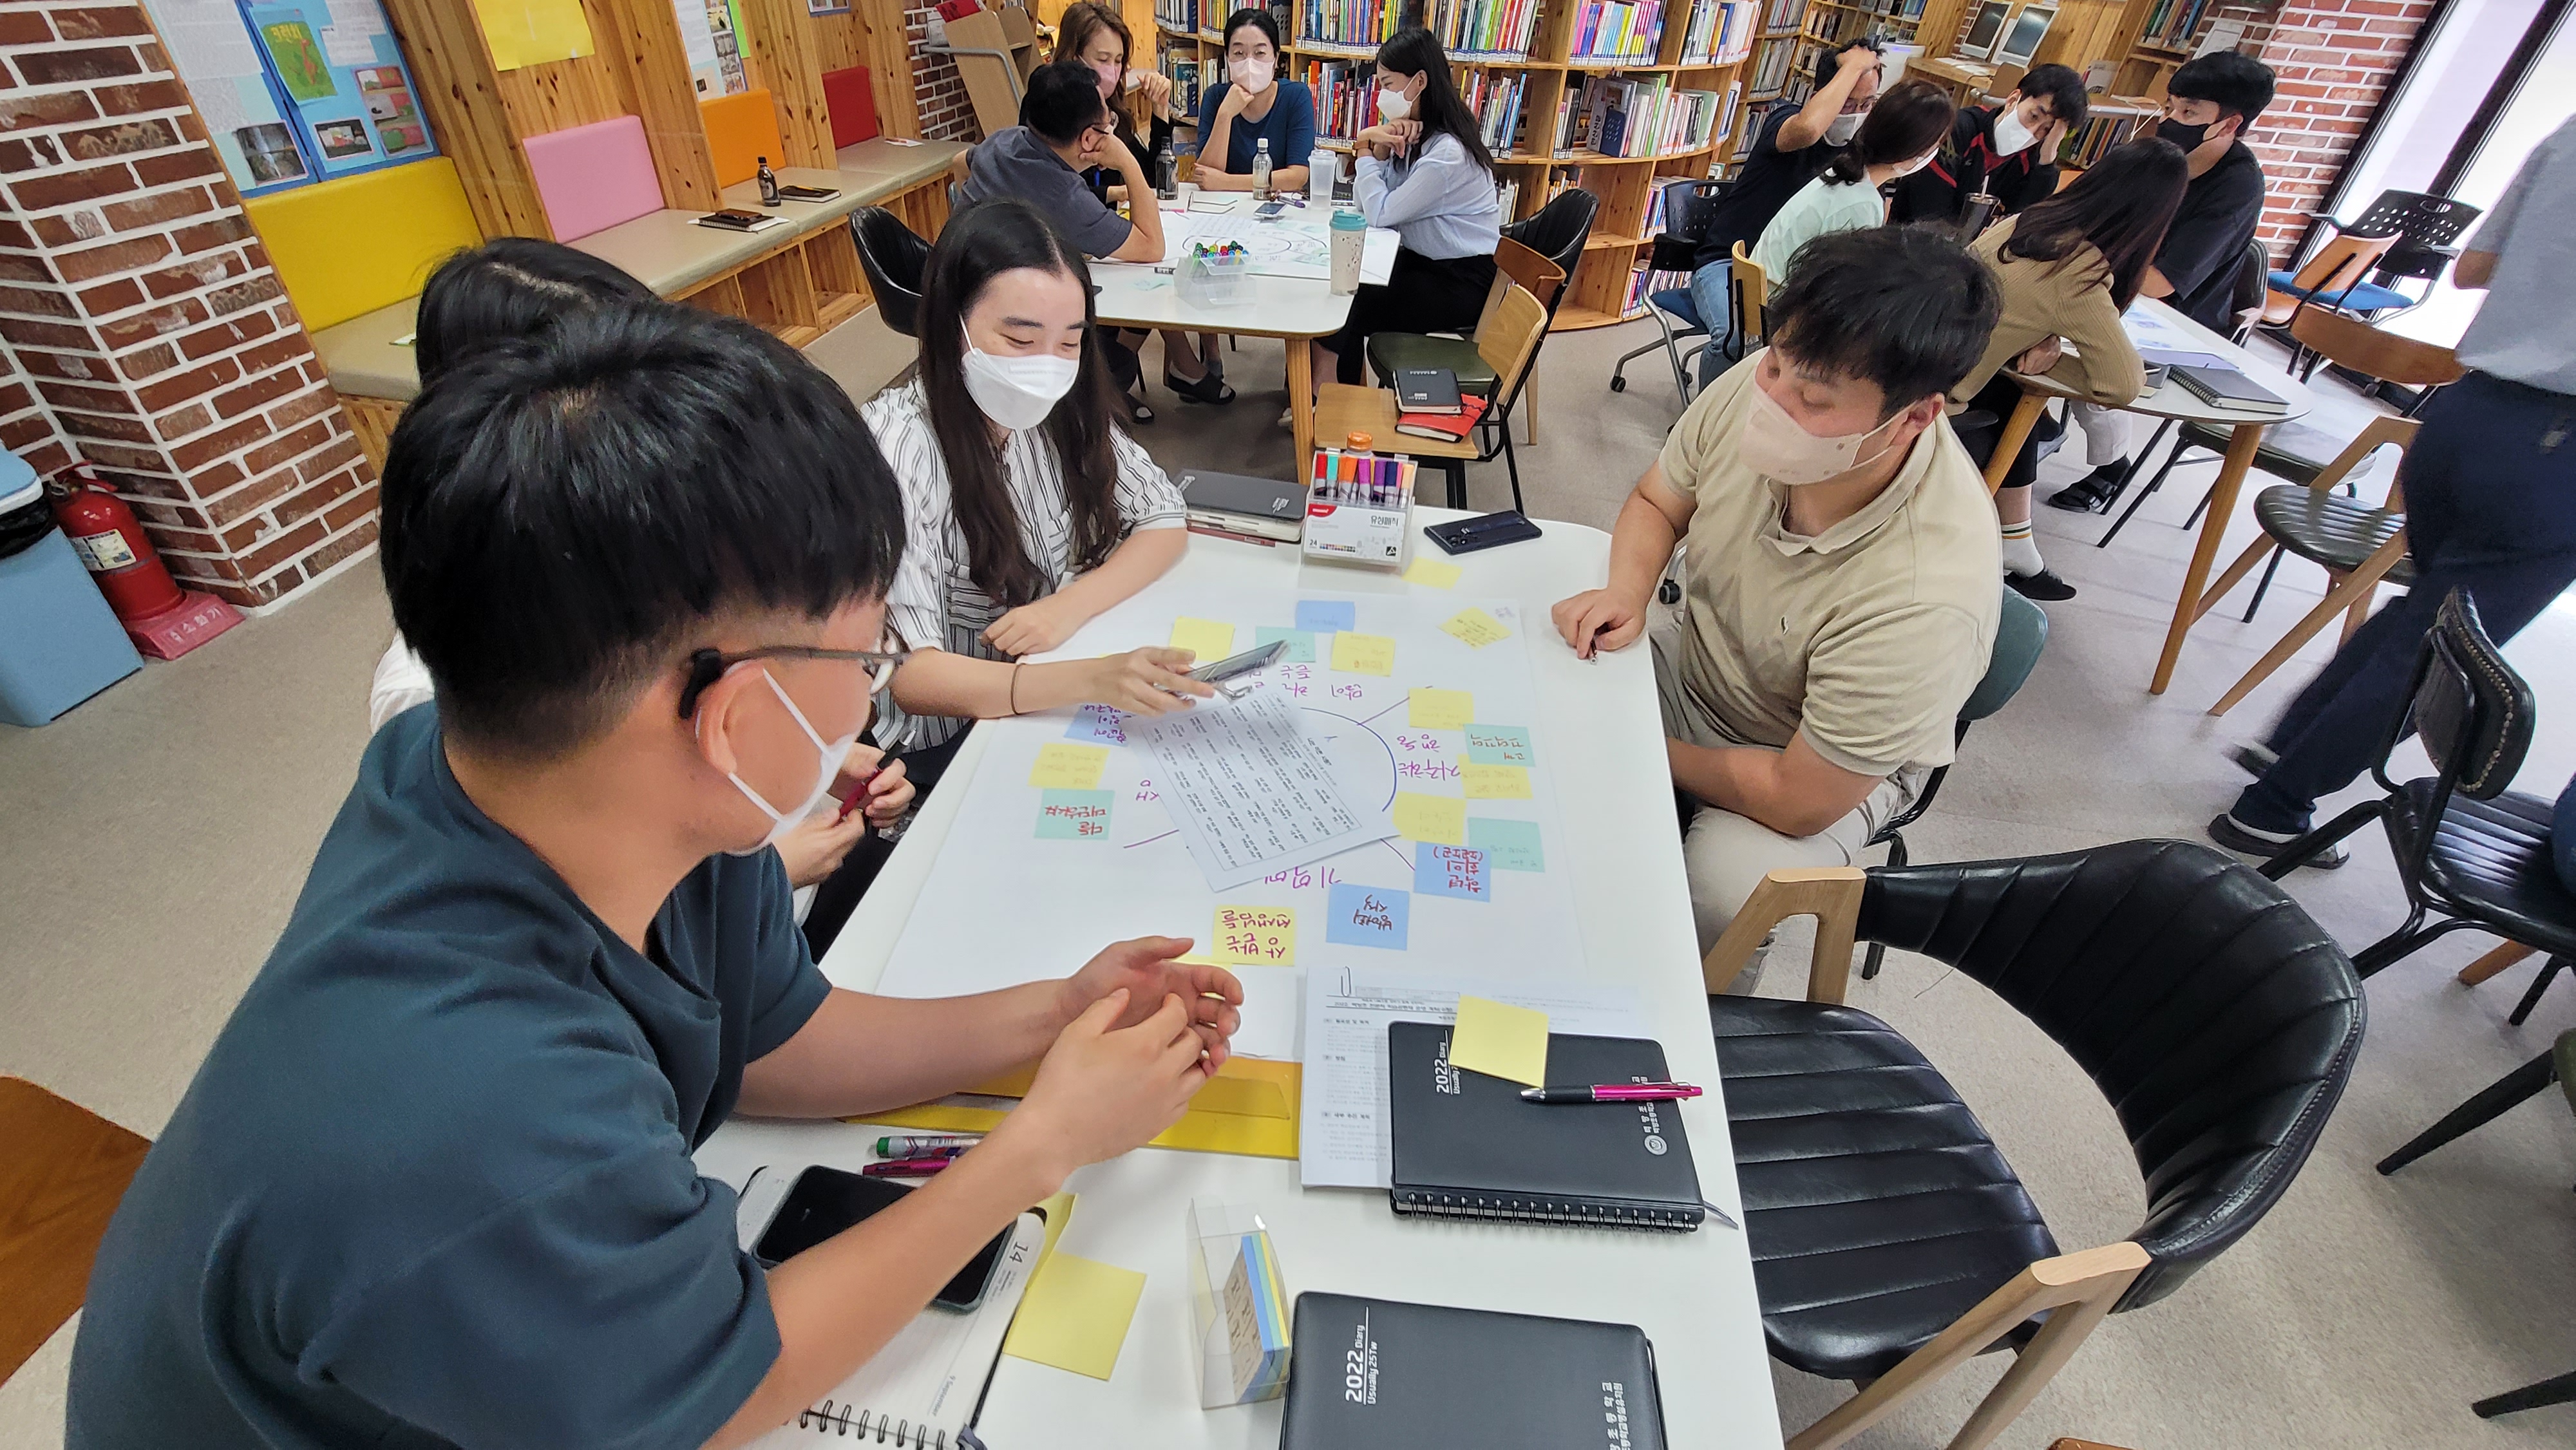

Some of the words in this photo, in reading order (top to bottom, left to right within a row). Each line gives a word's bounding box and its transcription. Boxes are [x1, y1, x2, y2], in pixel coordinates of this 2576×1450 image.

[182, 607, 222, 634] 소화기
[1331, 684, 1363, 701] 많이
[1397, 733, 1440, 753] 행동
[1470, 733, 1524, 748] 끄덕끄덕
[1397, 759, 1460, 782] 자주하는
[1448, 874, 1482, 893] 학년
[1220, 909, 1291, 930] 선생님들
[1225, 932, 1259, 956] 받는
[1264, 937, 1286, 959] 상
[1434, 1059, 1450, 1093] 2022
[1452, 1071, 1461, 1095] Usually
[1009, 1241, 1028, 1263] 14
[1354, 1324, 1365, 1349] Diary
[1345, 1350, 1364, 1403] 2022
[1367, 1368, 1379, 1405] Usually
[1613, 1382, 1631, 1450] 등학교병설유치원
